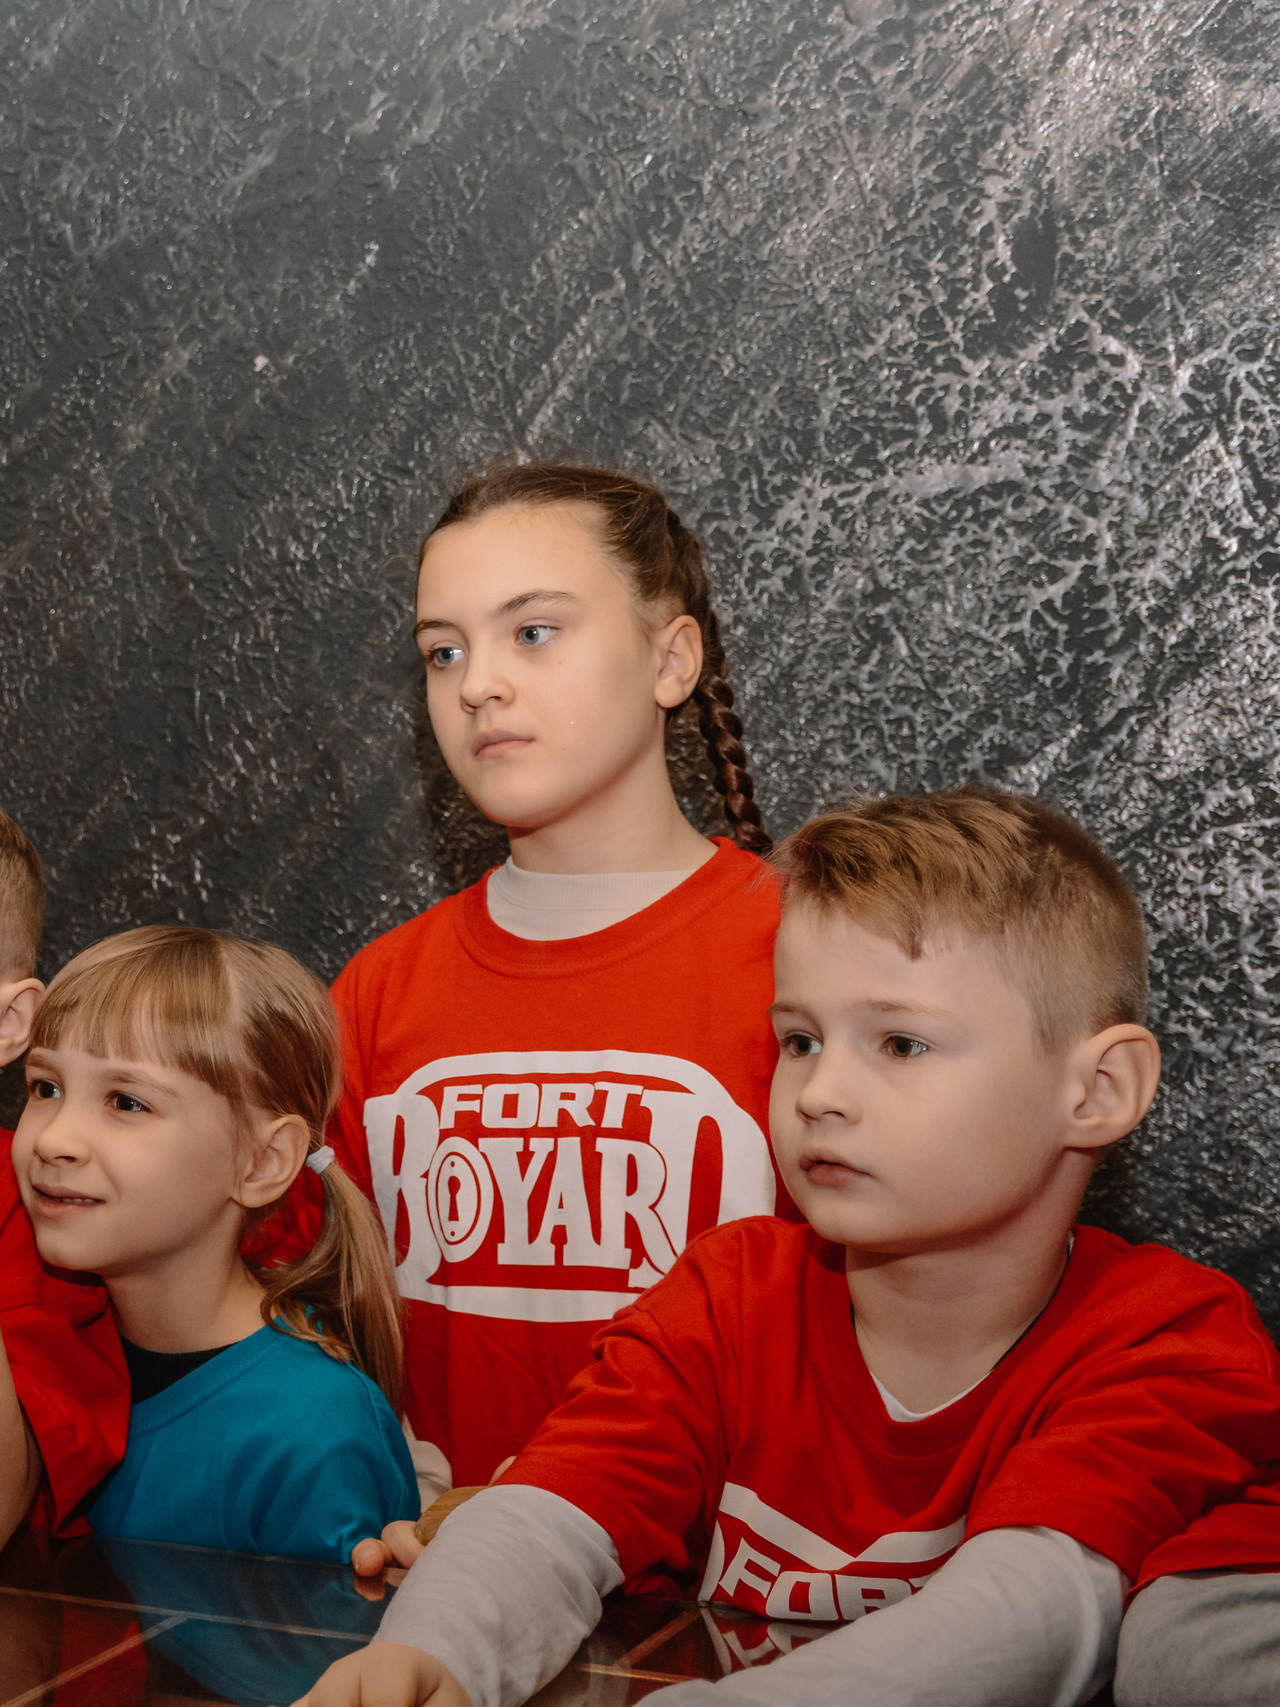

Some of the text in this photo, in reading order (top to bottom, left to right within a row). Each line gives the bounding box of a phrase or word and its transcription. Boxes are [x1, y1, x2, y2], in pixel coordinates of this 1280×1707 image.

[439, 1082, 644, 1130] FORT
[363, 1089, 776, 1300] BOYARD
[718, 1537, 925, 1622] FOR
